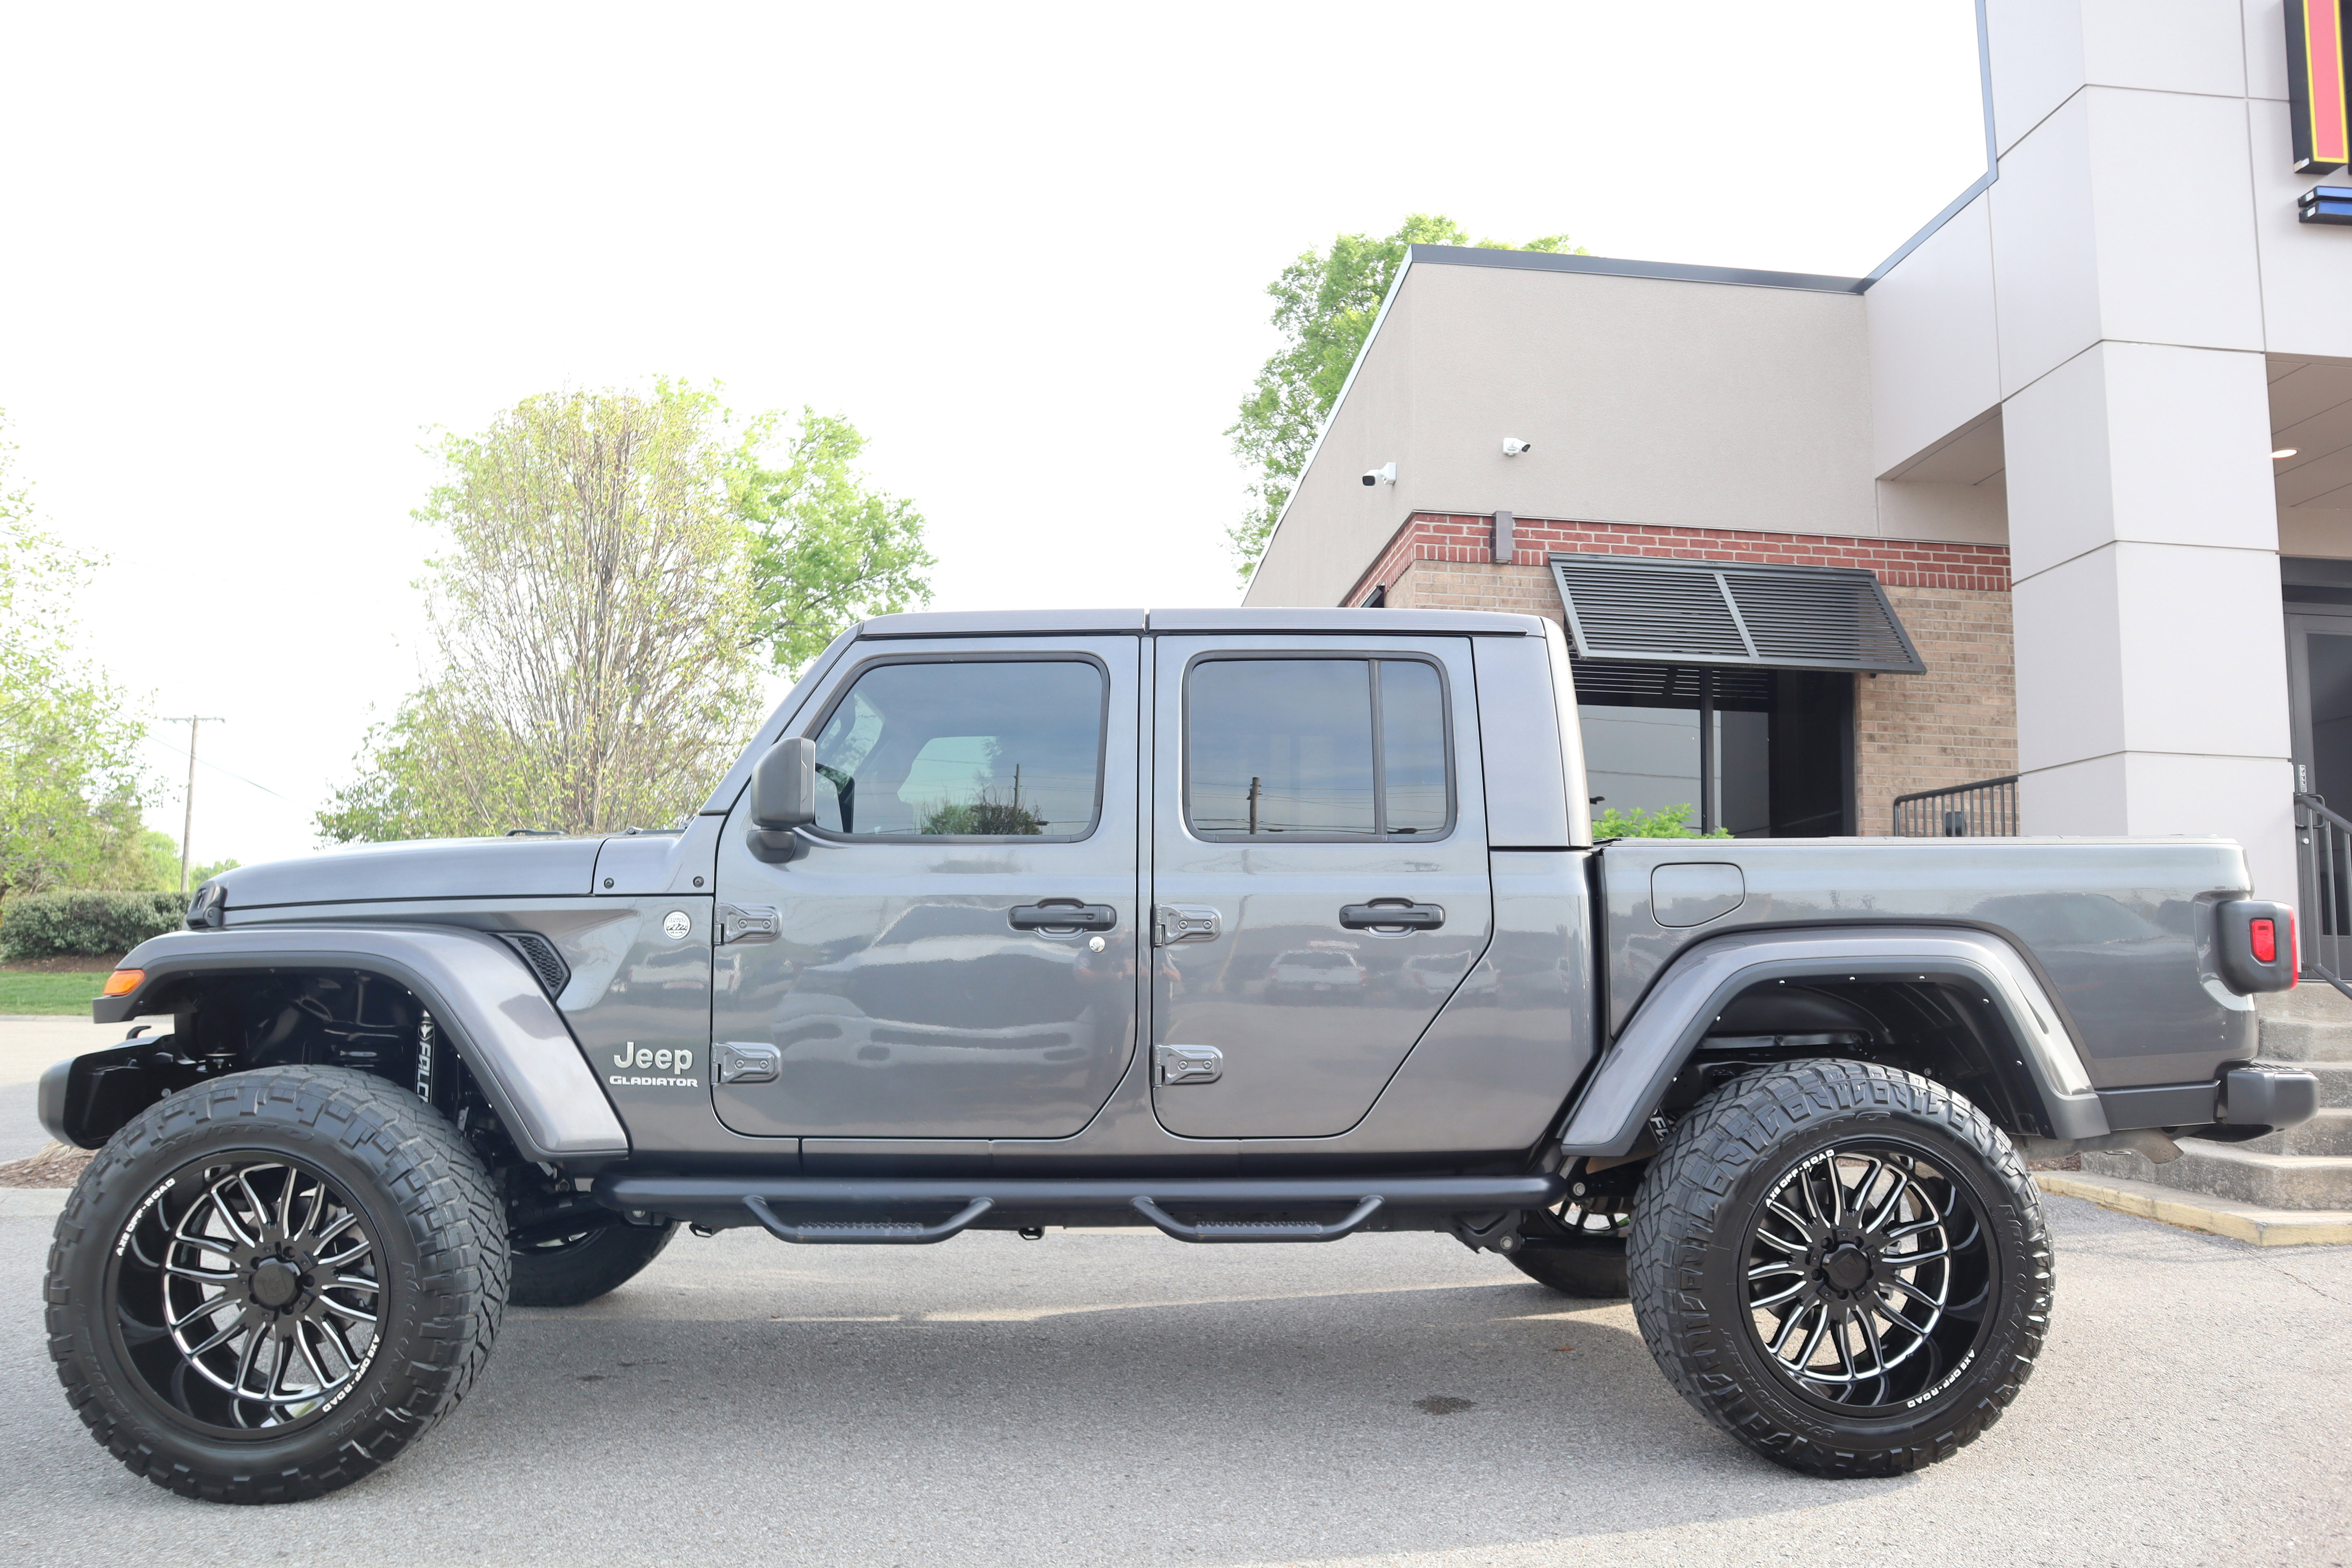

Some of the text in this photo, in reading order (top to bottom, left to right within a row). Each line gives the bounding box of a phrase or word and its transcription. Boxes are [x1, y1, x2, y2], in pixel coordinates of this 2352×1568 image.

[609, 1075, 698, 1087] GLADIATOR
[614, 1042, 693, 1075] Jeep
[1766, 1186, 1781, 1207] AXE
[1779, 1149, 1835, 1188] OFF-ROAD
[116, 1178, 176, 1256] AXE OFF-ROAD
[322, 1333, 380, 1412] AXE OFF-ROAD
[1907, 1349, 1975, 1408] AXE OFF-ROAD
